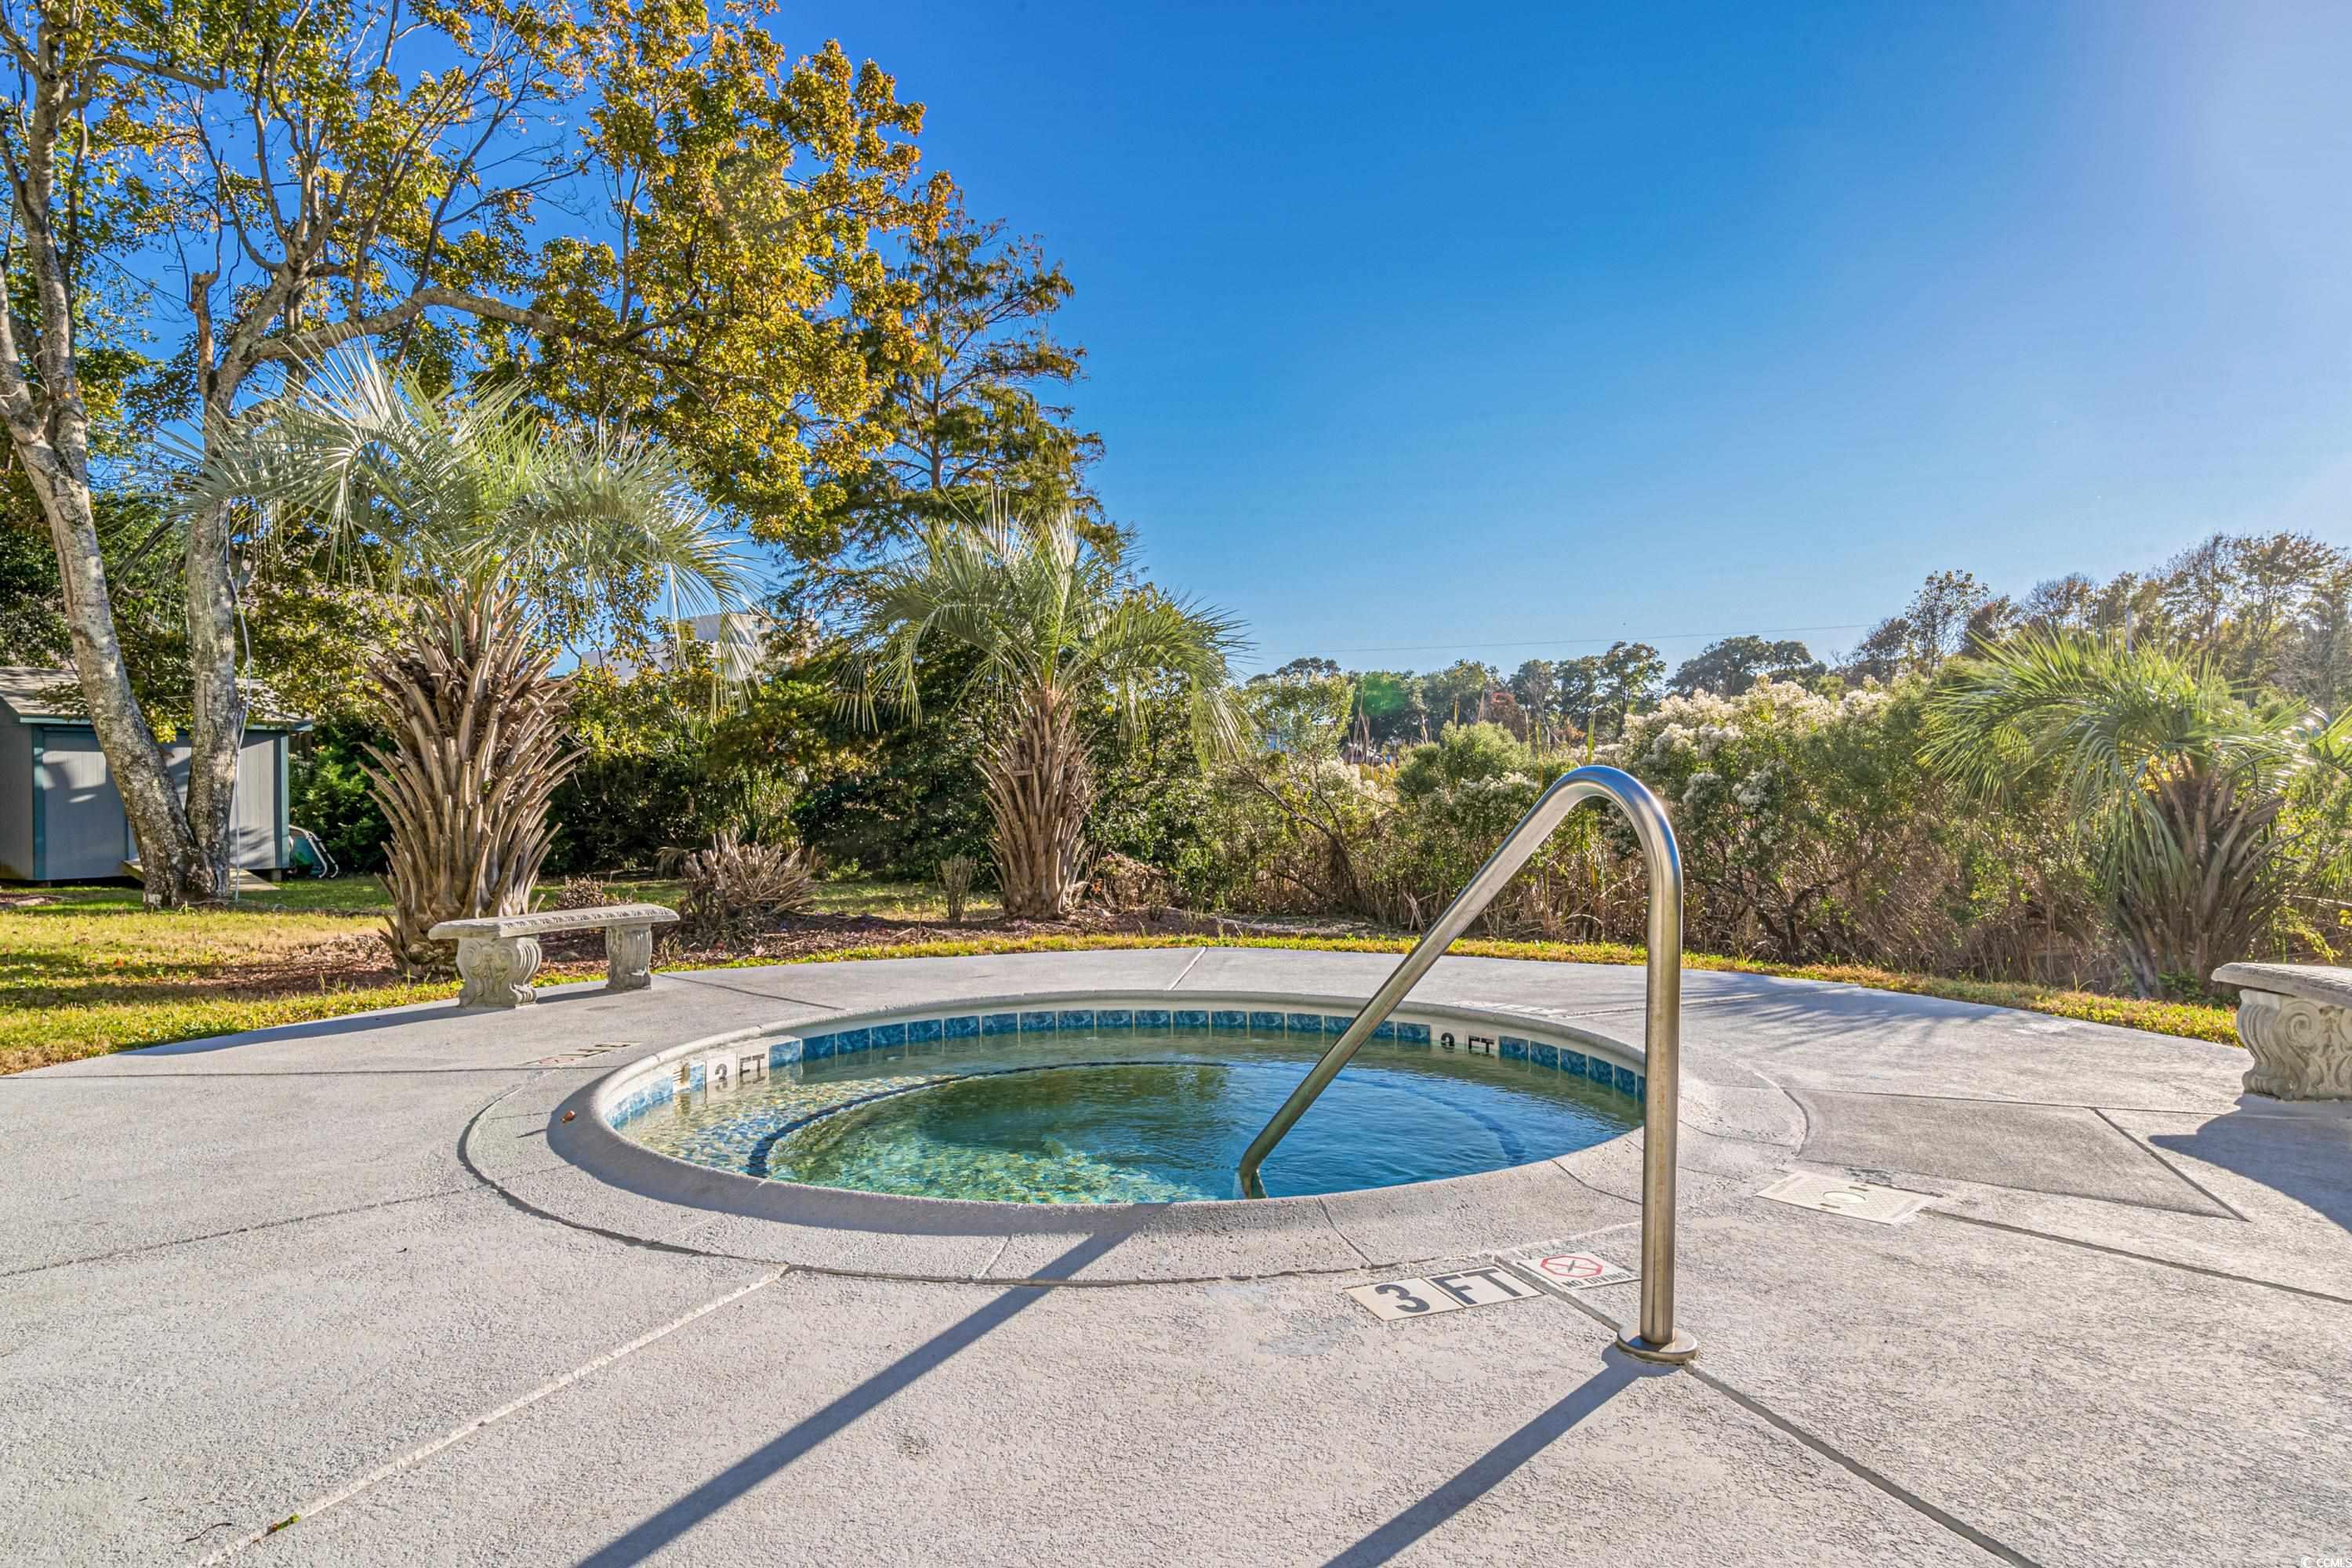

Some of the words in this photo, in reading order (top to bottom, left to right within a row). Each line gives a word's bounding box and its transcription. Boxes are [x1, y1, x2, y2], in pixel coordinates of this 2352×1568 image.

[739, 1053, 766, 1079] FT
[1374, 1283, 1431, 1313] 3
[1428, 1267, 1523, 1305] FT
[1562, 1279, 1584, 1287] NO
[1584, 1272, 1632, 1284] DIVING
